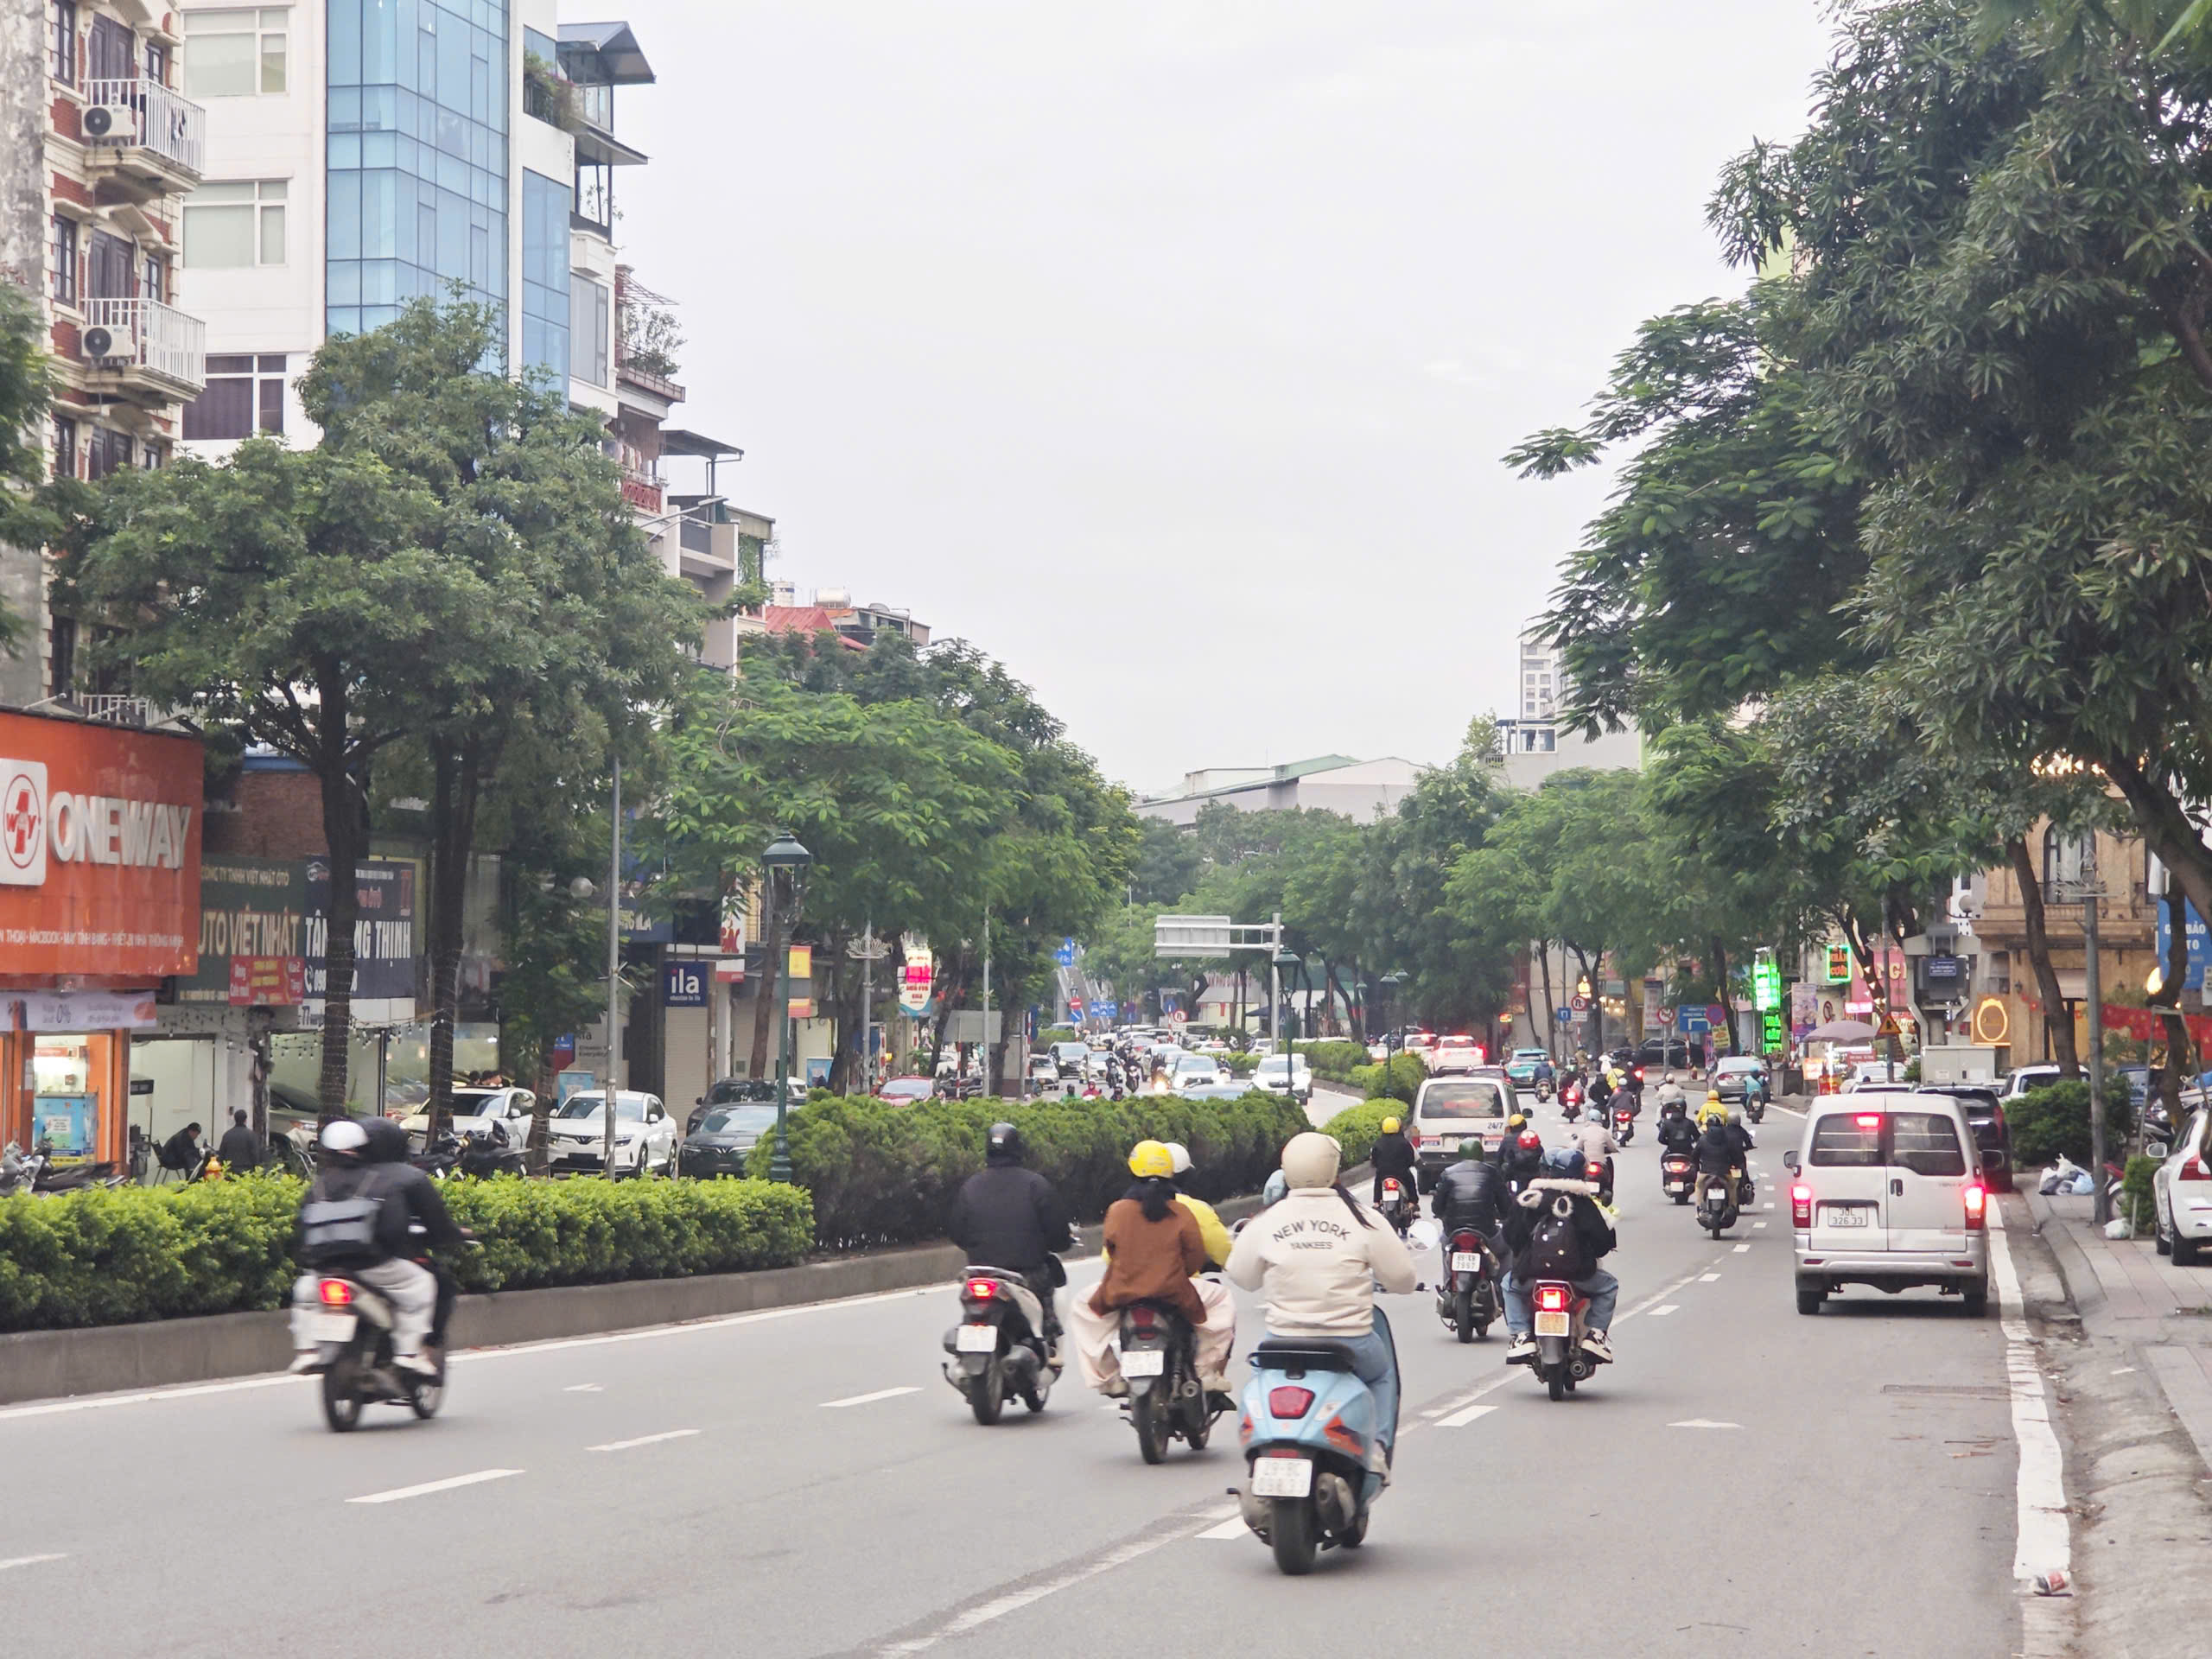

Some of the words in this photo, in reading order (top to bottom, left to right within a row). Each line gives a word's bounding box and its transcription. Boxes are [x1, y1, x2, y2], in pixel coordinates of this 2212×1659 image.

[49, 791, 192, 869] ONEWAY
[197, 911, 227, 956] UTO
[375, 920, 411, 968] THỊNH
[670, 968, 700, 994] ila
[1273, 1221, 1304, 1243] NEW
[1309, 1219, 1351, 1242] YORK
